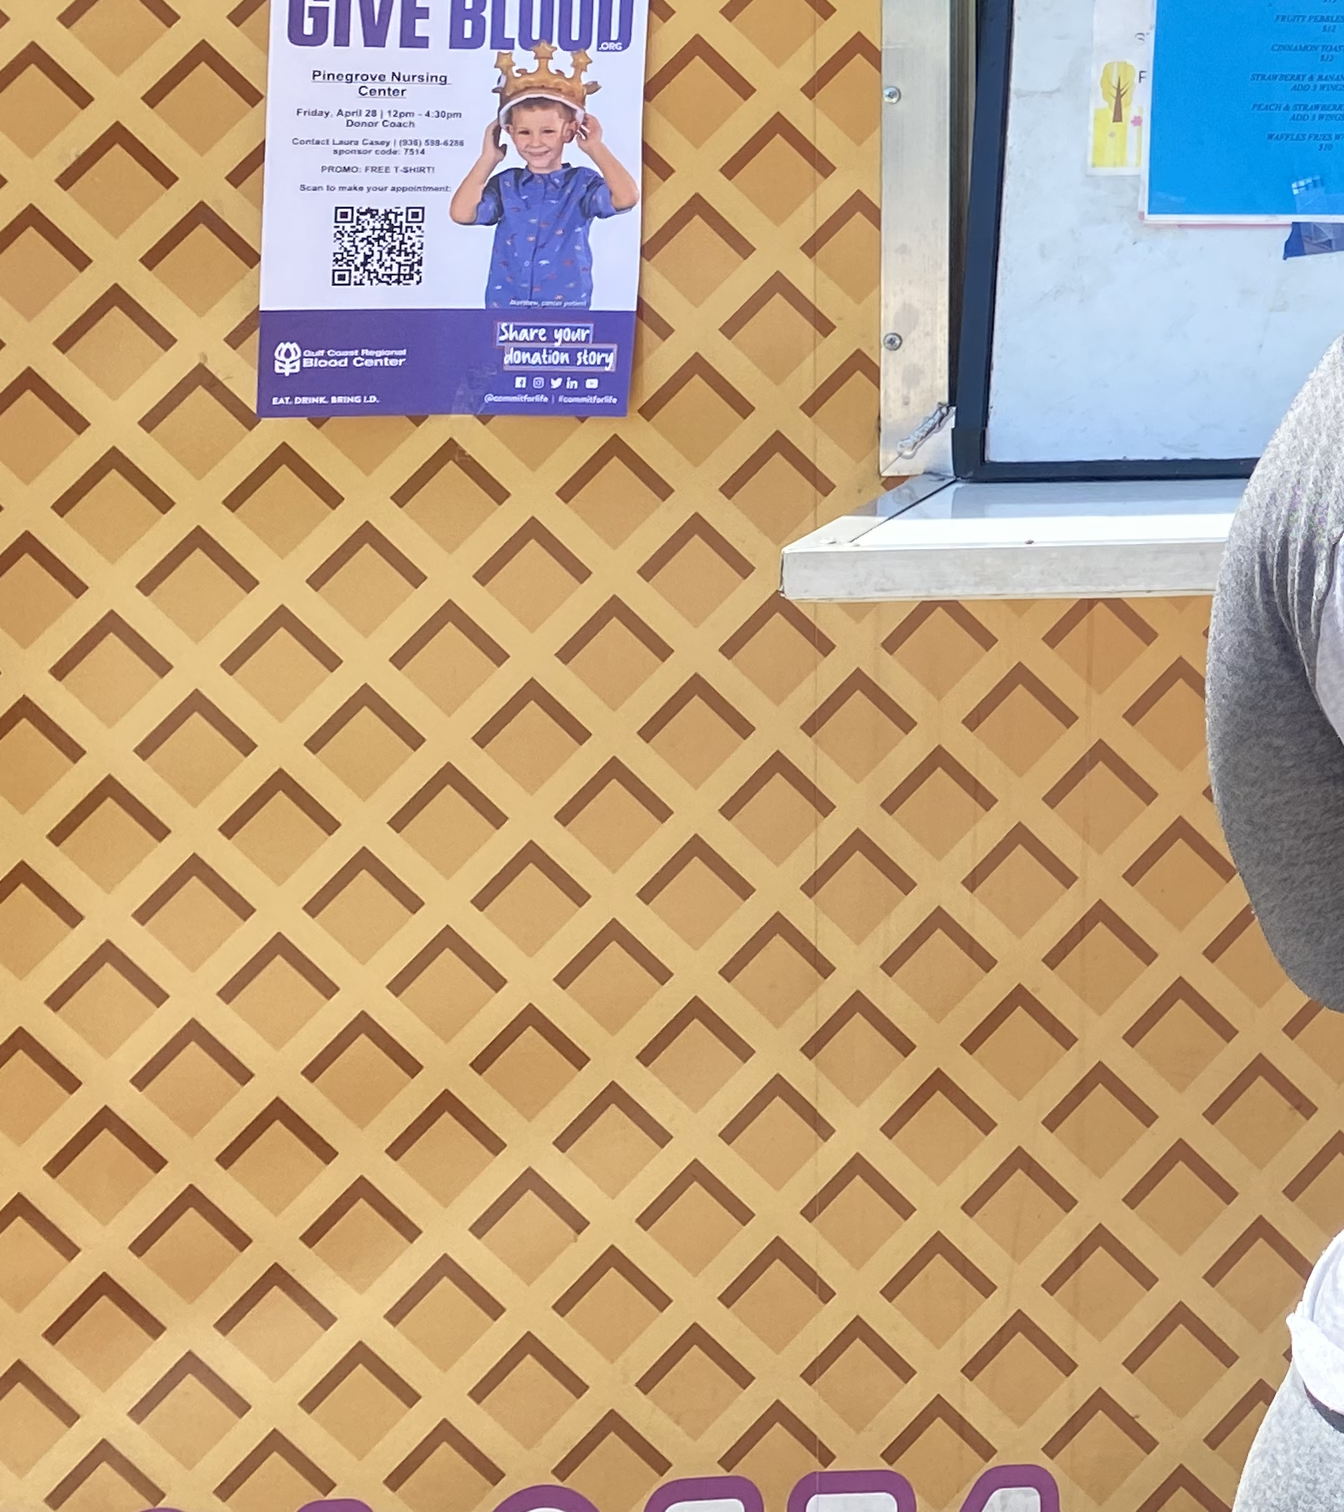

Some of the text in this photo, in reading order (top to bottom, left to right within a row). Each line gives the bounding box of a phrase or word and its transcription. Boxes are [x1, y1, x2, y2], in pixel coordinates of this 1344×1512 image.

[598, 41, 624, 52] .ORG
[1270, 44, 1318, 53] CINNAMON
[312, 70, 448, 85] Pinegrove Nursing
[1250, 73, 1307, 82] STRAWBERRY
[358, 85, 407, 97] Center
[1290, 83, 1312, 92] ADD
[1251, 103, 1283, 112] PEACH
[296, 108, 334, 119] Friday,
[336, 109, 362, 119] April
[364, 109, 377, 118] 28
[387, 110, 415, 119] 12pm
[424, 110, 462, 120] 4:30pm
[1288, 113, 1310, 122] ADD
[346, 119, 415, 128] Donor Coach
[292, 137, 330, 146] Contact
[332, 138, 359, 146] Laura
[1266, 133, 1308, 142] WAFFLES
[1307, 133, 1332, 142] FRIES
[333, 148, 372, 157] sponsor
[403, 148, 426, 156] 7514
[321, 165, 435, 175] PROMO: FREE T-SHIRT!
[299, 184, 324, 192] Scan
[326, 184, 336, 192] to
[366, 185, 388, 194] your
[498, 322, 591, 347] Share your
[327, 349, 359, 357] Coast
[361, 348, 407, 358] Regional
[302, 357, 407, 368] Blood Center
[504, 347, 615, 371] donation story
[272, 396, 293, 405] EAT.
[294, 396, 329, 405] DRINK.
[330, 395, 362, 404] BRING
[484, 393, 549, 404] @commitforlife
